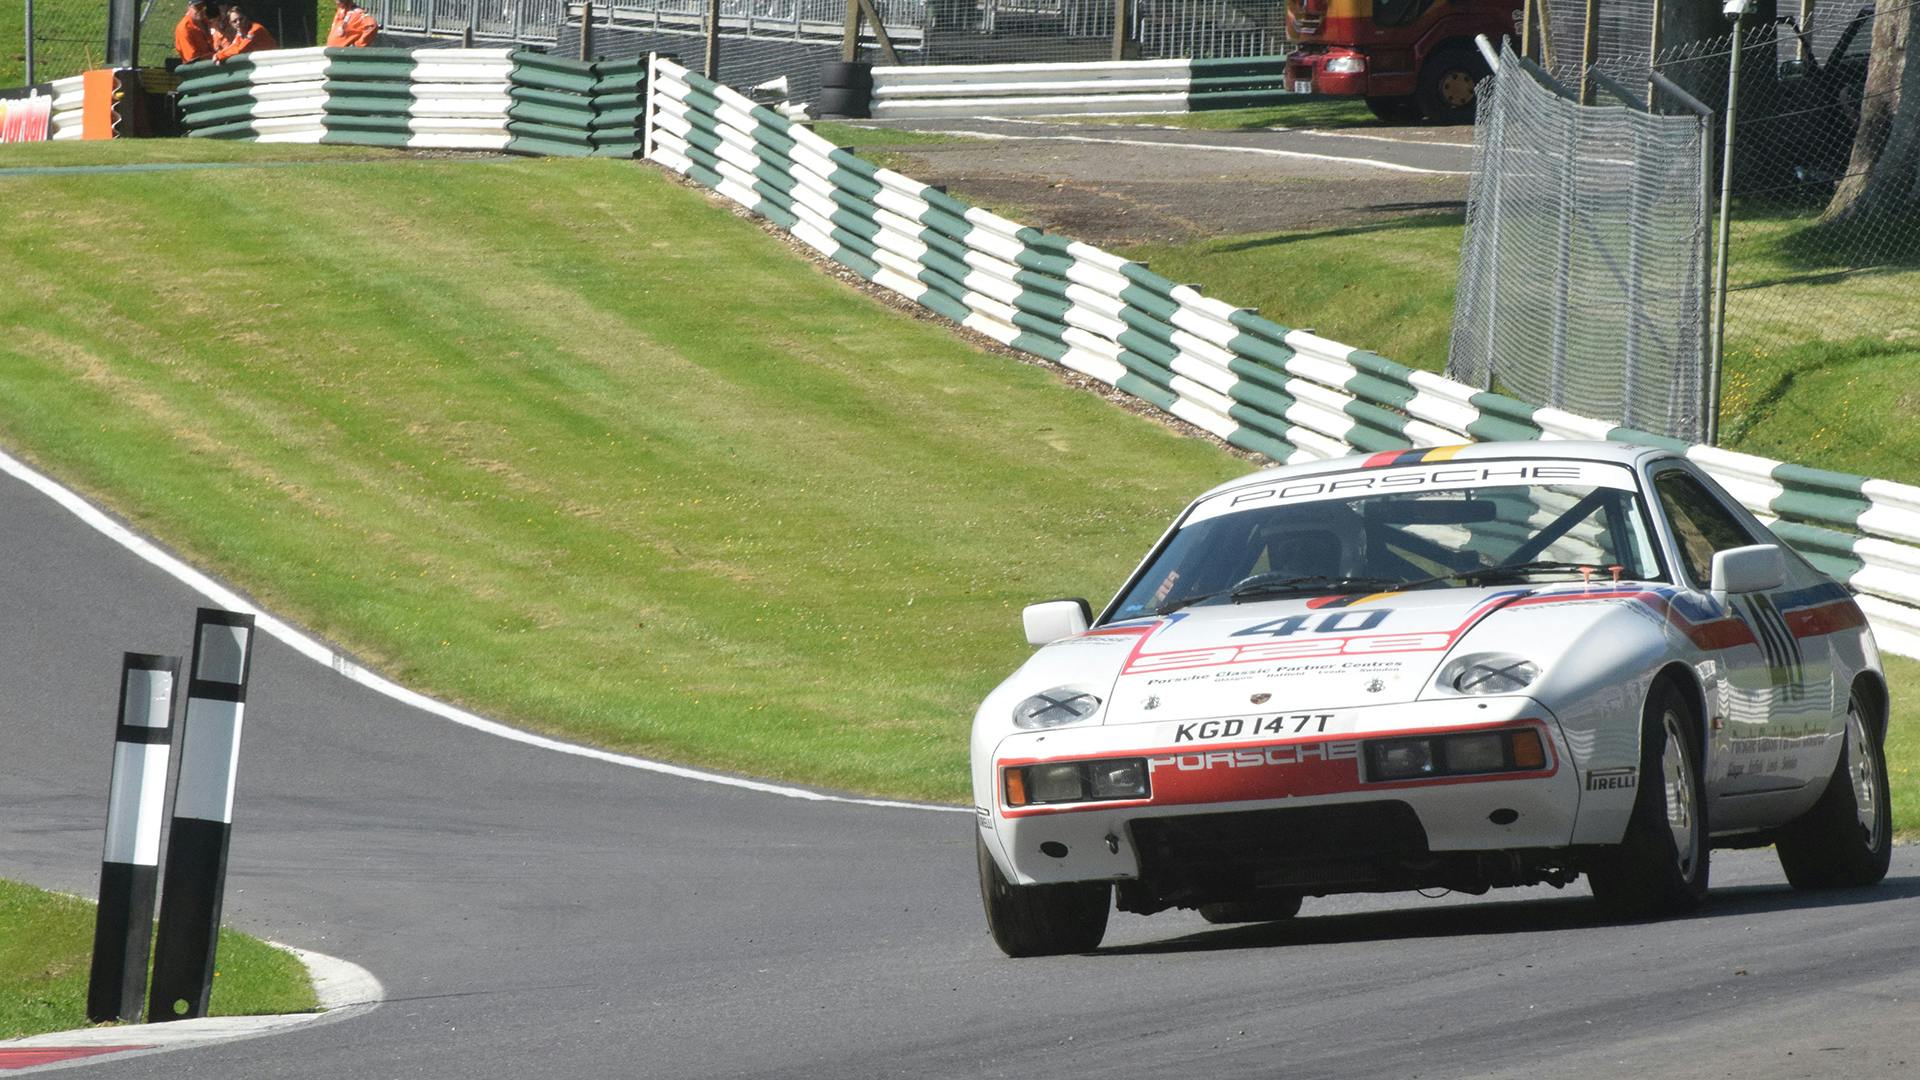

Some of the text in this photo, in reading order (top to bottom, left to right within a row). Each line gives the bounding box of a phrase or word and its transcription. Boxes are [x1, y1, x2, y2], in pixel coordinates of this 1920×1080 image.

[1229, 466, 1581, 508] PORSCHE
[1229, 608, 1394, 638] 40
[1127, 631, 1453, 673] 928
[1147, 660, 1404, 686] Porsche Classic Partner Centres
[1174, 714, 1335, 743] KGD 147T
[1149, 742, 1358, 773] PORSCHE
[1585, 765, 1636, 791] PIRELLI
